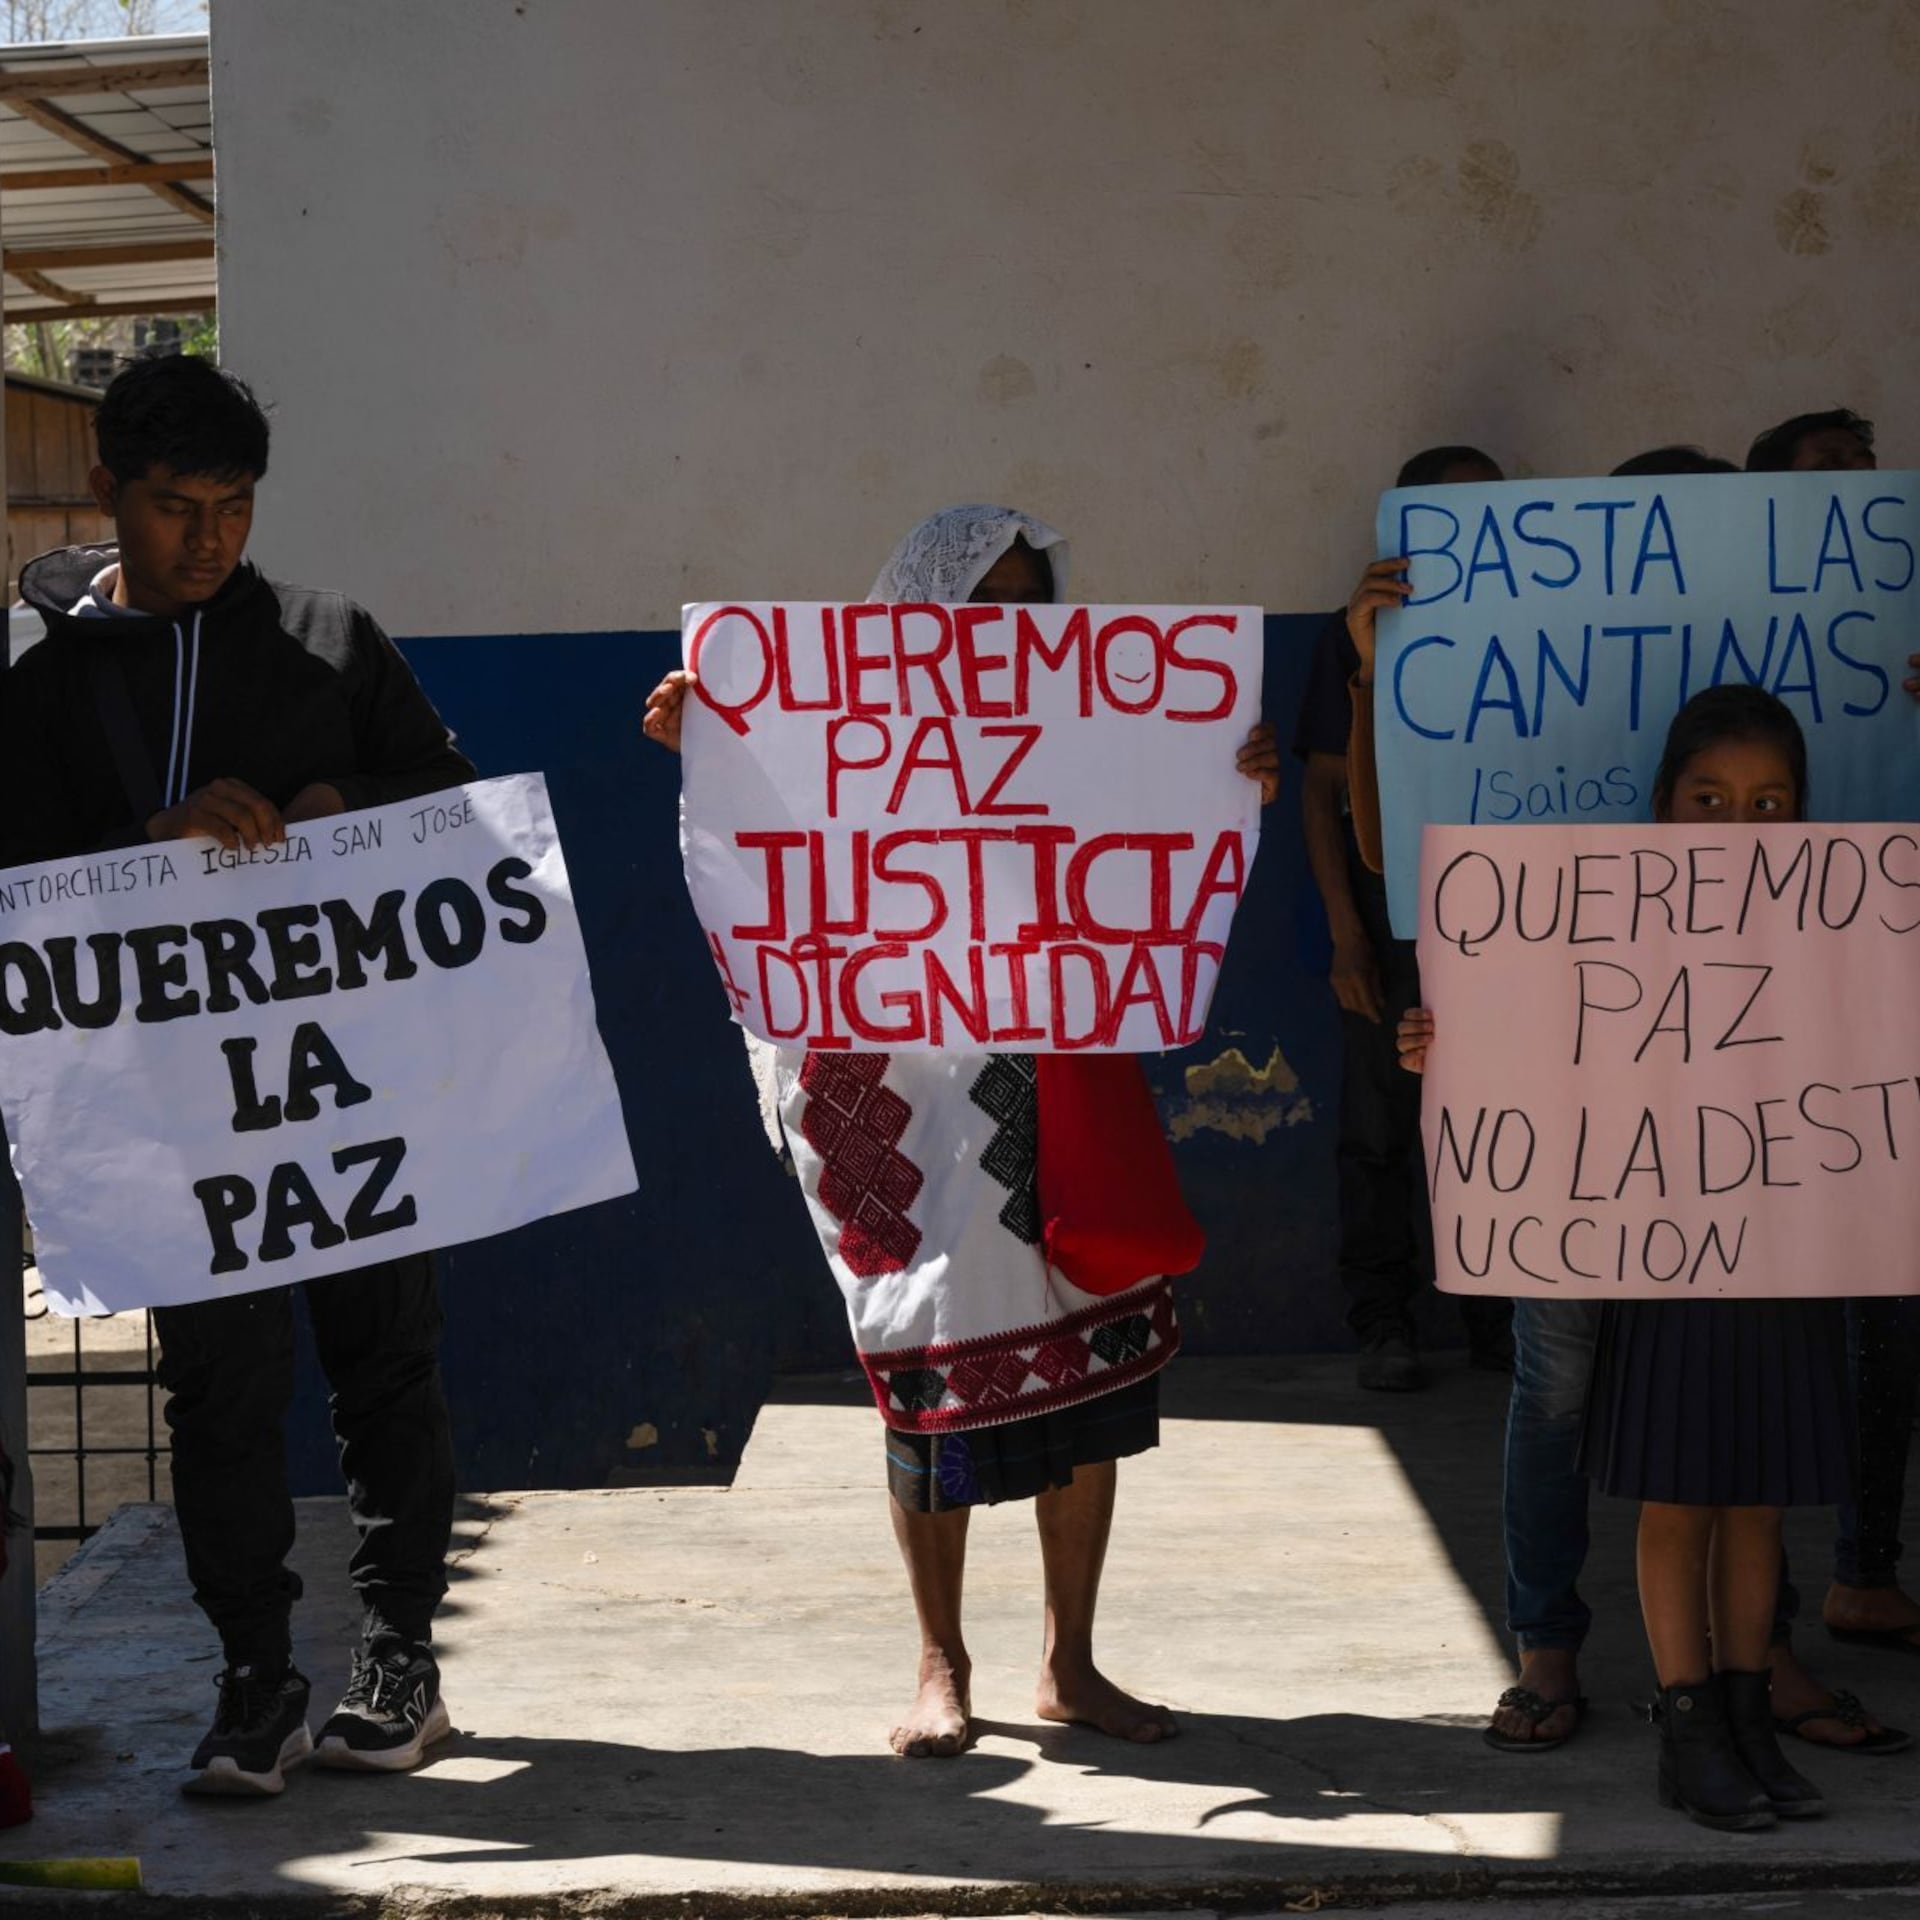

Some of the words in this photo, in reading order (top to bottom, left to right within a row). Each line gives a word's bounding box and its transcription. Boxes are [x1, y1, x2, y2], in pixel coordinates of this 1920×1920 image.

[1400, 494, 1686, 607] BASTA
[1768, 495, 1915, 594] LAS
[690, 604, 1238, 736] QUEREMOS
[1393, 611, 1890, 744] CANTINAS
[826, 714, 1049, 818] PAZ
[200, 836, 313, 875] IGLESIA
[332, 819, 383, 857] SAN
[731, 825, 1245, 946] JUSTICIA
[1434, 834, 1920, 957] QUEREMOS
[0, 857, 547, 1036] QUEREMOS
[756, 934, 1226, 1050] DIGNIDAD
[1573, 961, 1784, 1065] PAZ
[220, 1021, 372, 1133] LA
[1432, 1105, 1536, 1204] NO
[1569, 1105, 1666, 1201] LA
[1696, 1075, 1920, 1196] DEST
[193, 1136, 417, 1275] PAZ
[1455, 1214, 1747, 1285] UCCION
